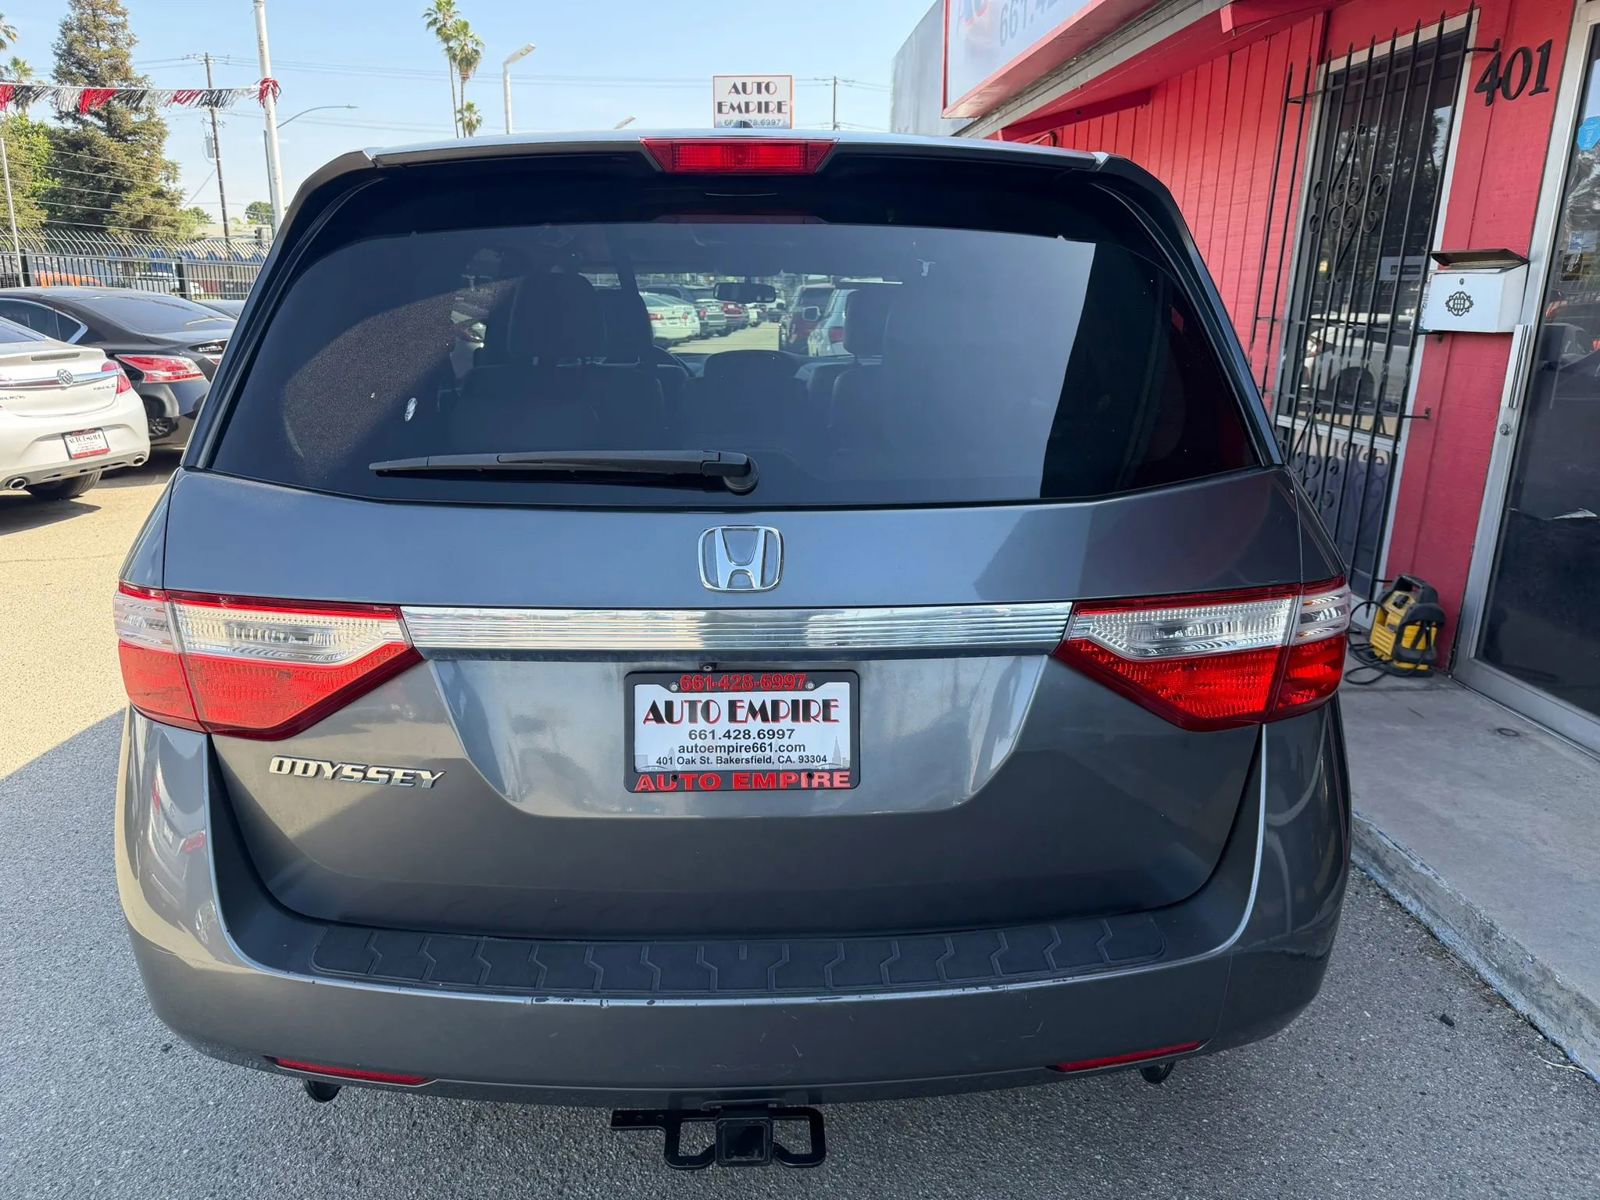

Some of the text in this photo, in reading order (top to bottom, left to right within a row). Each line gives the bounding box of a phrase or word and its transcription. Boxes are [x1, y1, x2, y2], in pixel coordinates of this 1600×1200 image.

[1000, 0, 1056, 47] 661.
[1474, 39, 1552, 107] 401
[728, 81, 777, 95] AUTO
[717, 100, 787, 114] EMPIRE
[643, 699, 839, 724] AUTO EMPIRE
[688, 728, 795, 740] 661.428.6997
[678, 741, 806, 754] autoempire661.com
[656, 754, 828, 766] 401 Oak St. Bakersfield, CA. 93304
[268, 755, 447, 789] ODYSSEY
[634, 772, 850, 792] AUTO EMPIRE
